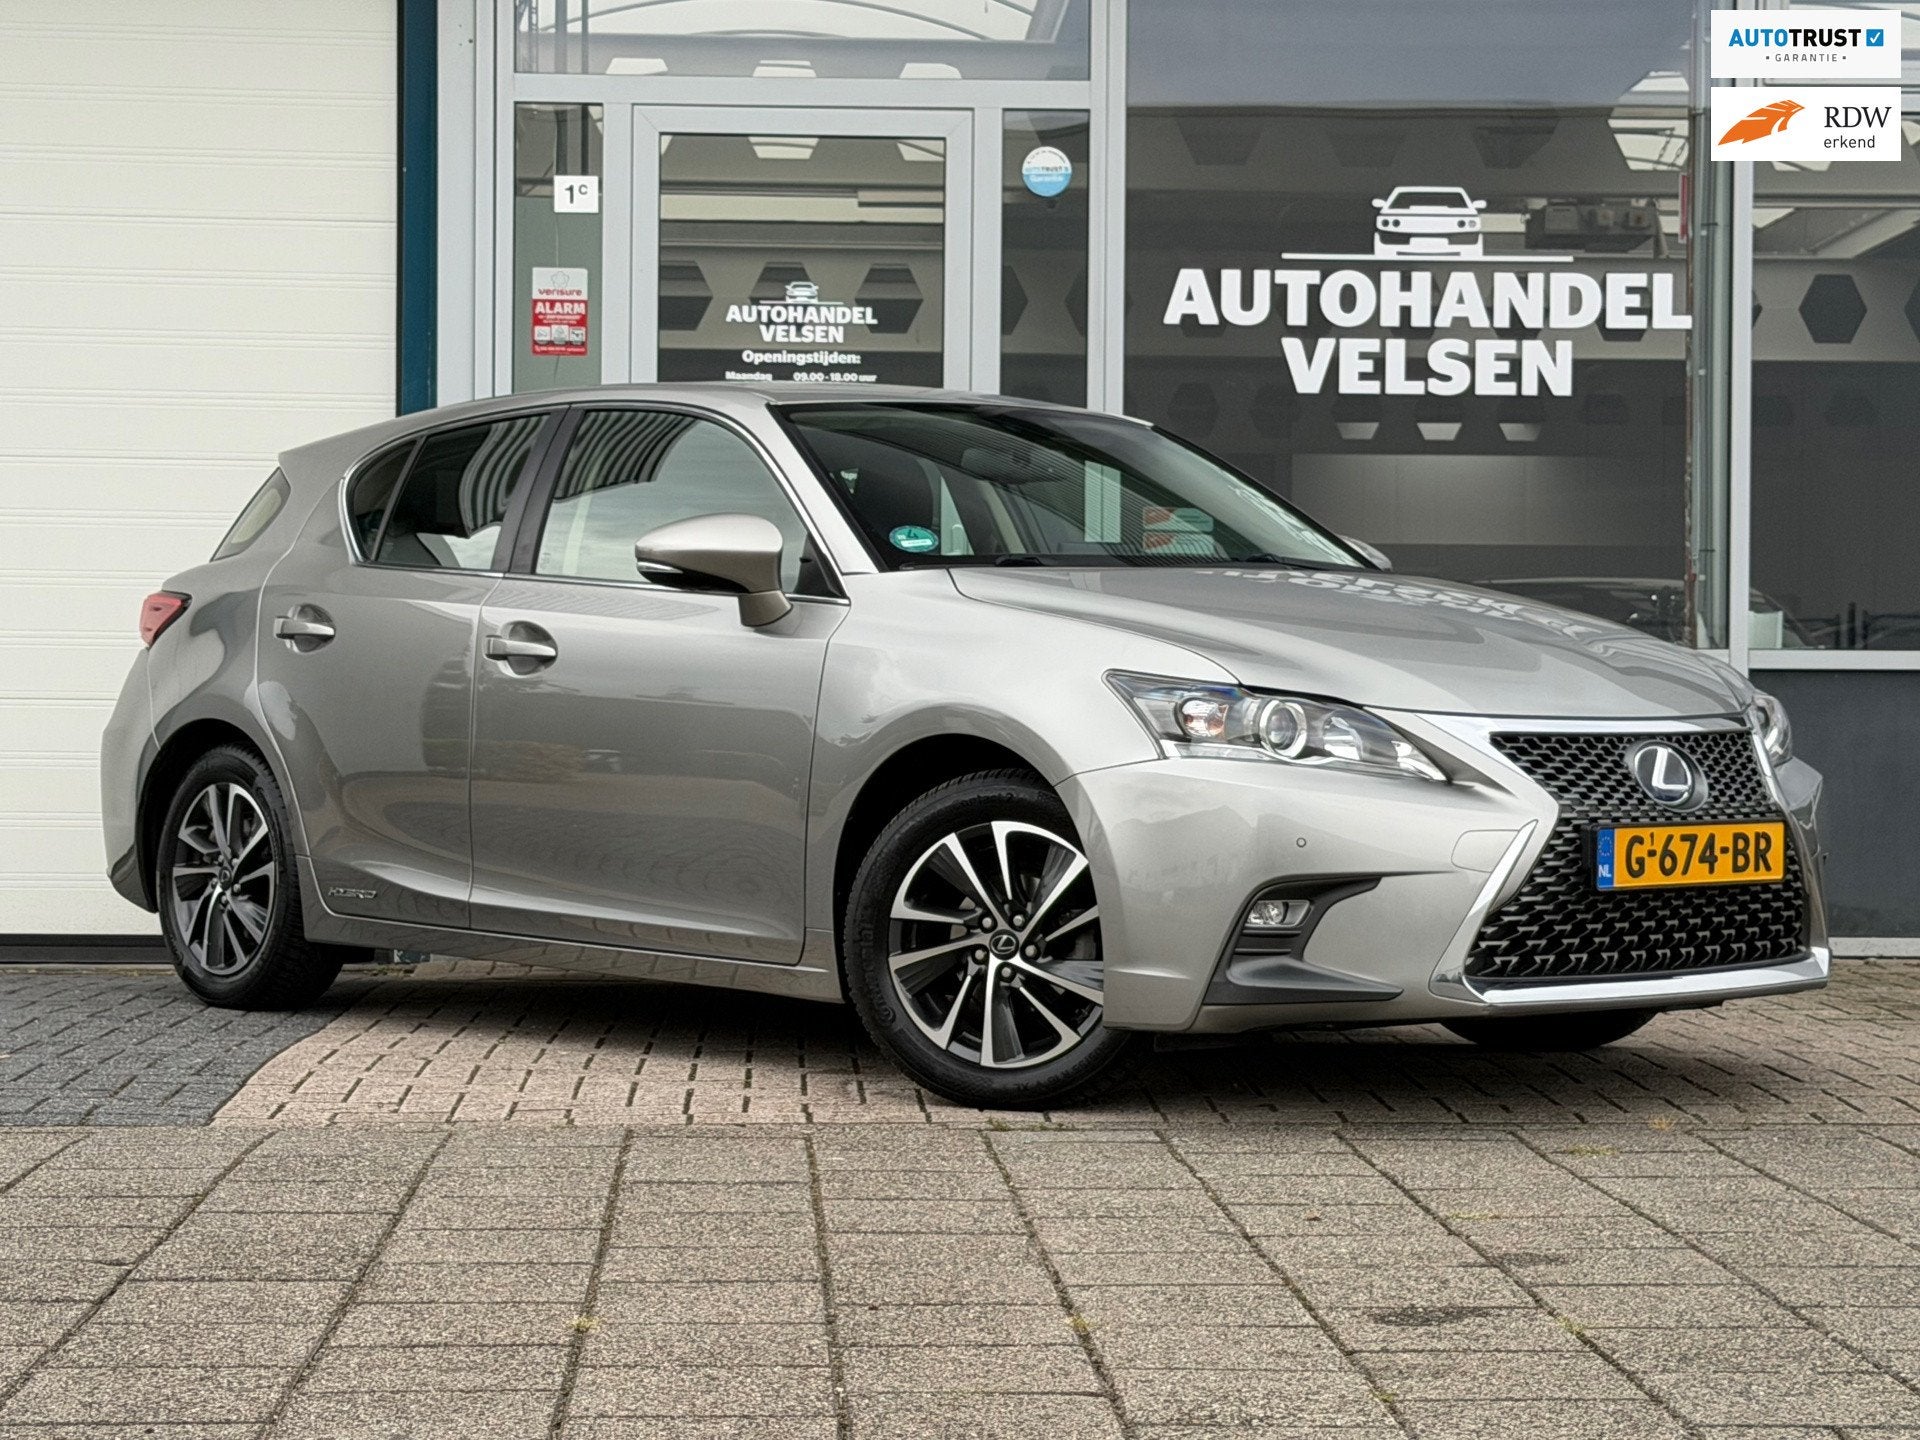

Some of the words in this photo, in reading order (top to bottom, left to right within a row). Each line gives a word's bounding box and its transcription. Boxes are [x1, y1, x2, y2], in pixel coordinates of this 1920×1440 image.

[534, 301, 586, 315] ALARM
[1162, 268, 1693, 330] AUTOHANDEL
[725, 304, 879, 325] AUTOHANDEL
[759, 325, 844, 344] VELSEN
[741, 350, 862, 366] Openingstijden:
[1280, 337, 1574, 397] VELSEN
[1598, 863, 1612, 878] NL
